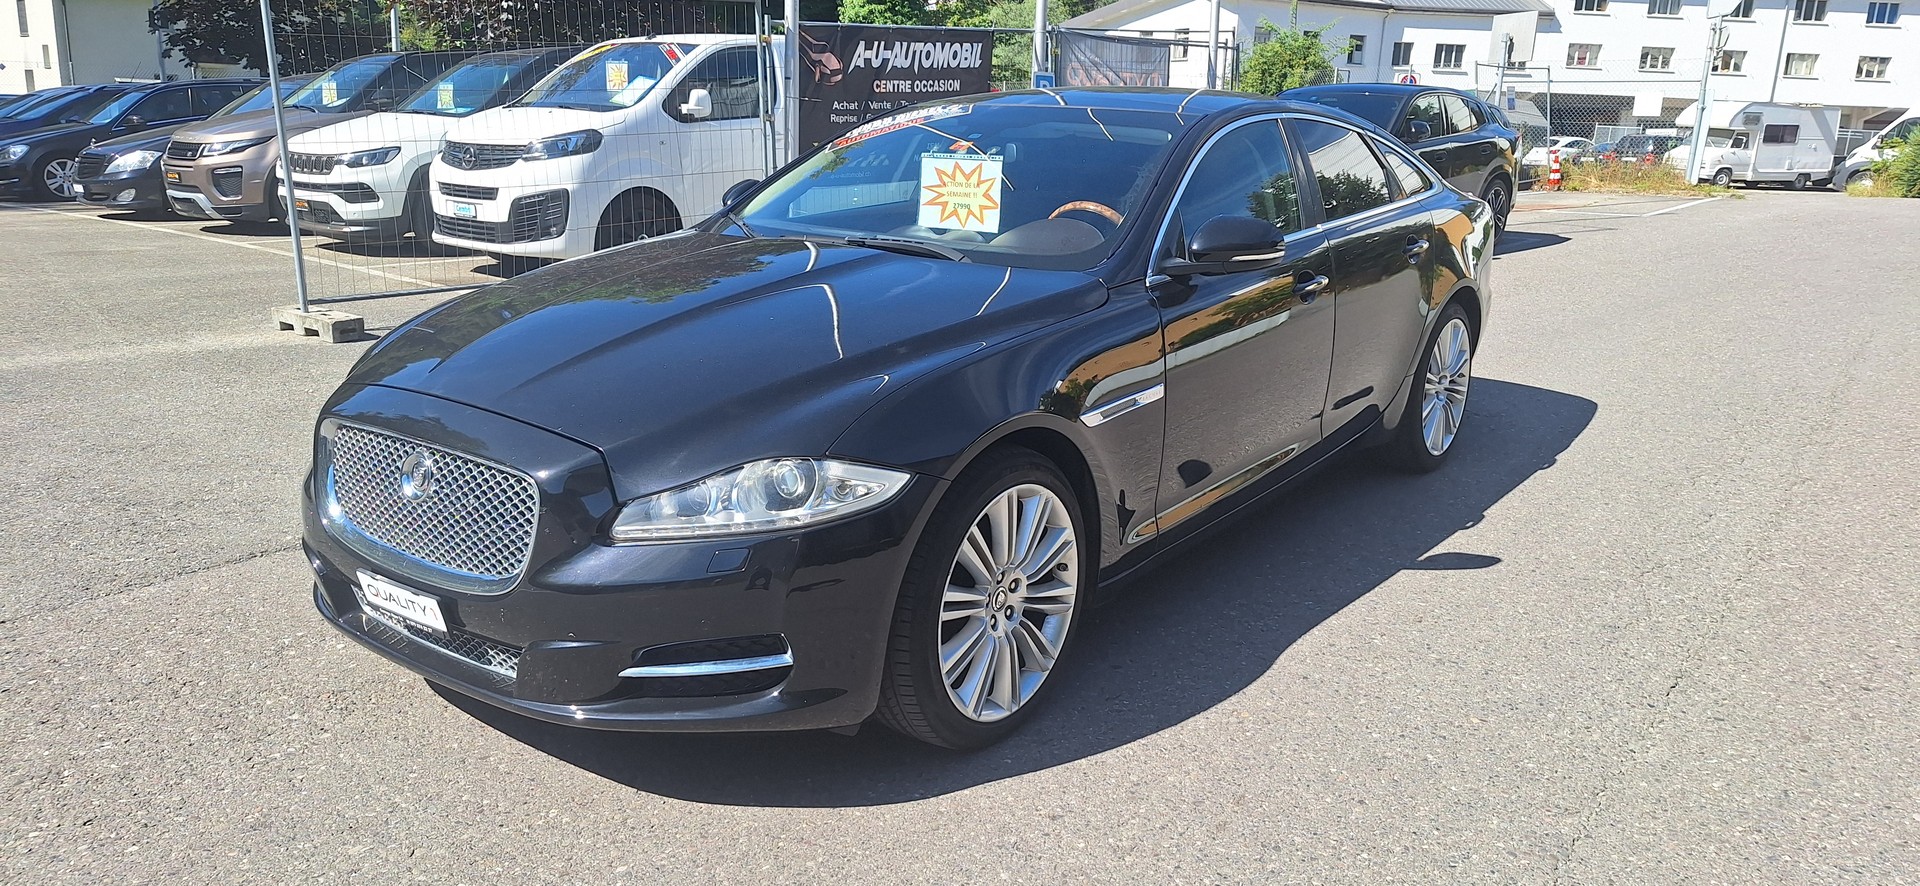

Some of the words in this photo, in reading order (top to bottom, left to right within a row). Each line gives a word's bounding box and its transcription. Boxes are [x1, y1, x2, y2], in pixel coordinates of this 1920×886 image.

[847, 40, 983, 74] A-U-AUTOMOBIL
[873, 80, 912, 93] CENTRE
[914, 79, 961, 92] OCCASION
[832, 100, 859, 110] Achat
[868, 100, 892, 110] Vente
[830, 114, 858, 124] Reprise
[946, 190, 972, 198] SEMAINE
[367, 583, 427, 616] QUALITY
